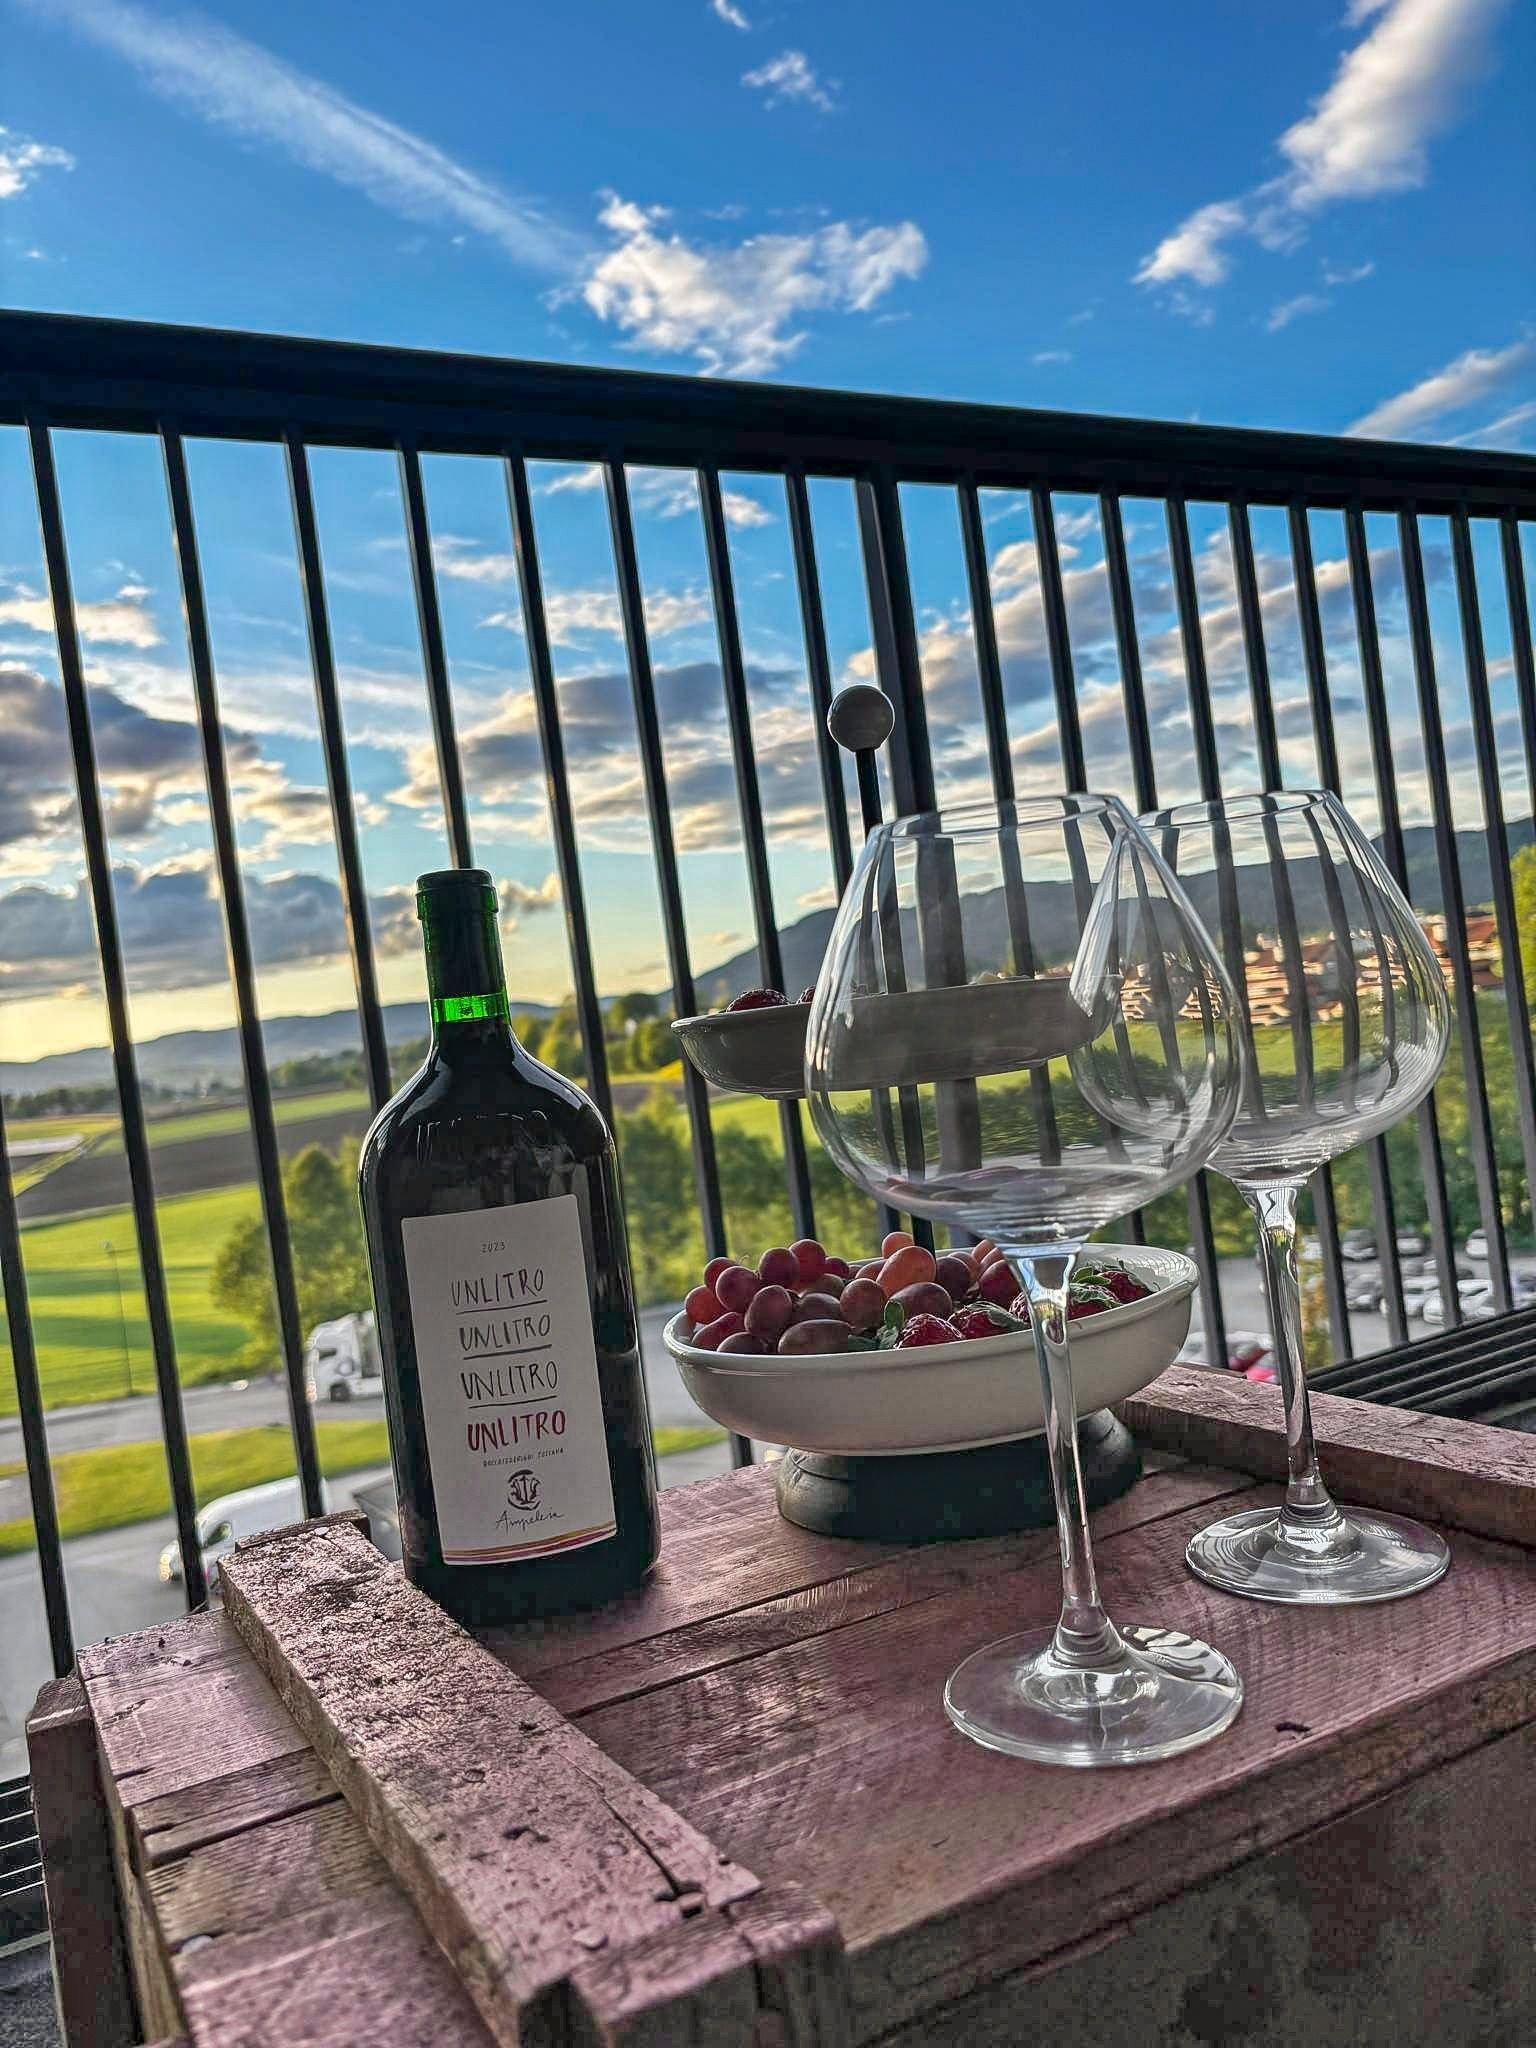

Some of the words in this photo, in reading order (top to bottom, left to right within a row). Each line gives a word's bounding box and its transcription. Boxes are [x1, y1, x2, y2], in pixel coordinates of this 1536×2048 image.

[451, 1267, 544, 1307] UNLITRO
[459, 1314, 551, 1351] UNLITRO
[460, 1360, 558, 1401] UNLITRO
[467, 1410, 566, 1454] UNLITRO
